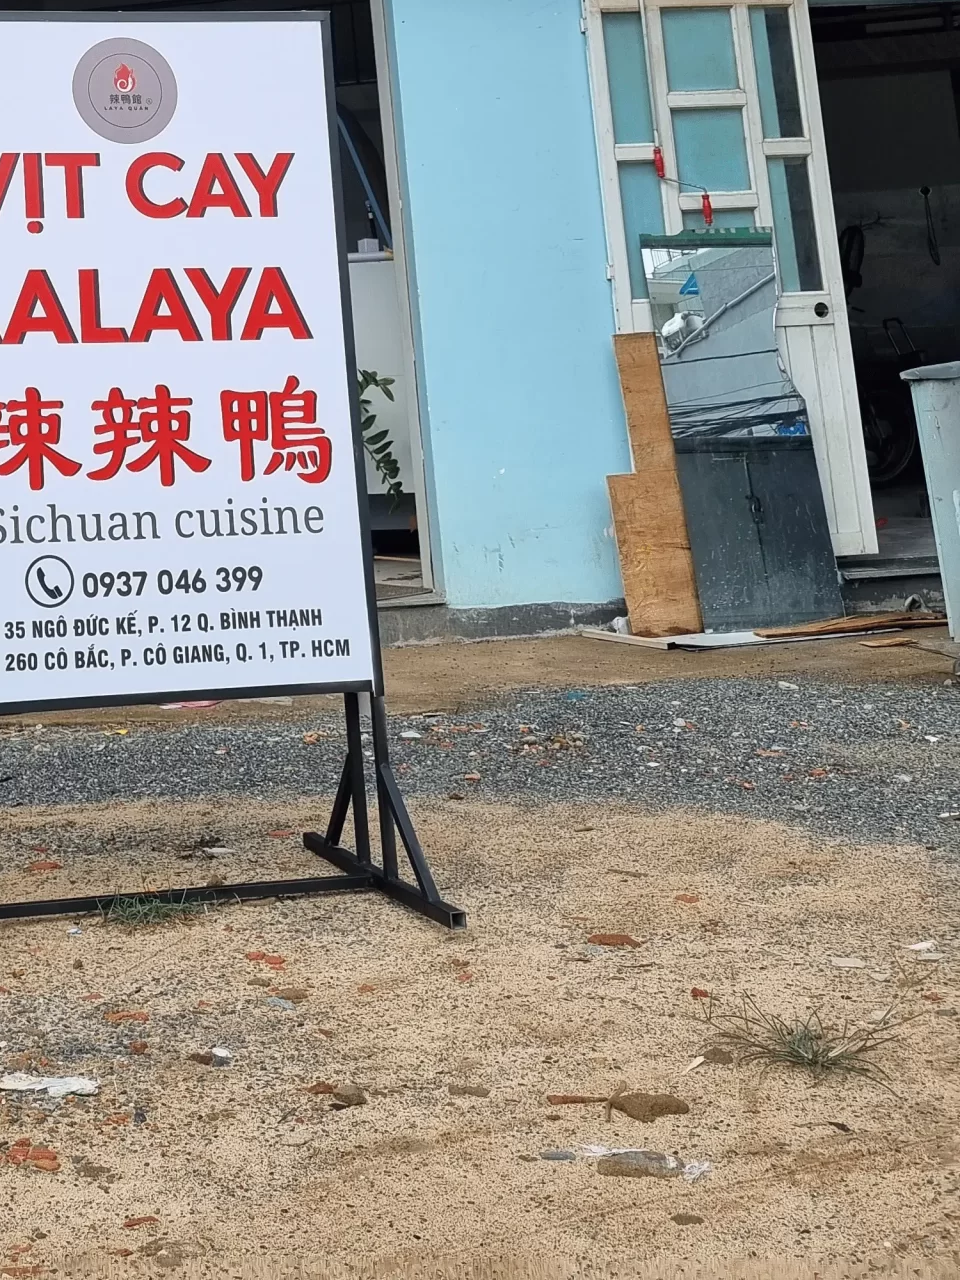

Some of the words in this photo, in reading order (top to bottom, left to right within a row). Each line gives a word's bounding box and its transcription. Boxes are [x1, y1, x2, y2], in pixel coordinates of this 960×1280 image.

[125, 151, 295, 219] CAY
[174, 497, 325, 539] cuisine
[82, 570, 148, 599] 0937
[157, 568, 207, 595] 046
[215, 565, 264, 593] 399
[4, 620, 26, 640] 35
[32, 614, 68, 639] NGÔ
[73, 613, 110, 638] ĐỨC
[115, 609, 143, 638] KẾ,
[148, 615, 165, 634] P.
[171, 613, 192, 632] 12
[197, 612, 215, 632] Q.
[220, 608, 262, 631] BÌNH
[266, 608, 323, 632] THẠNH
[5, 652, 39, 672] 260
[44, 645, 69, 670] CÔ
[74, 643, 115, 671] BẮC,
[121, 648, 137, 667] P.
[143, 643, 167, 666] CÔ
[172, 643, 230, 666] GIANG,
[235, 644, 253, 663] Q.
[258, 642, 274, 664] 1,
[279, 640, 306, 660] TP.
[311, 638, 352, 658] HCM
